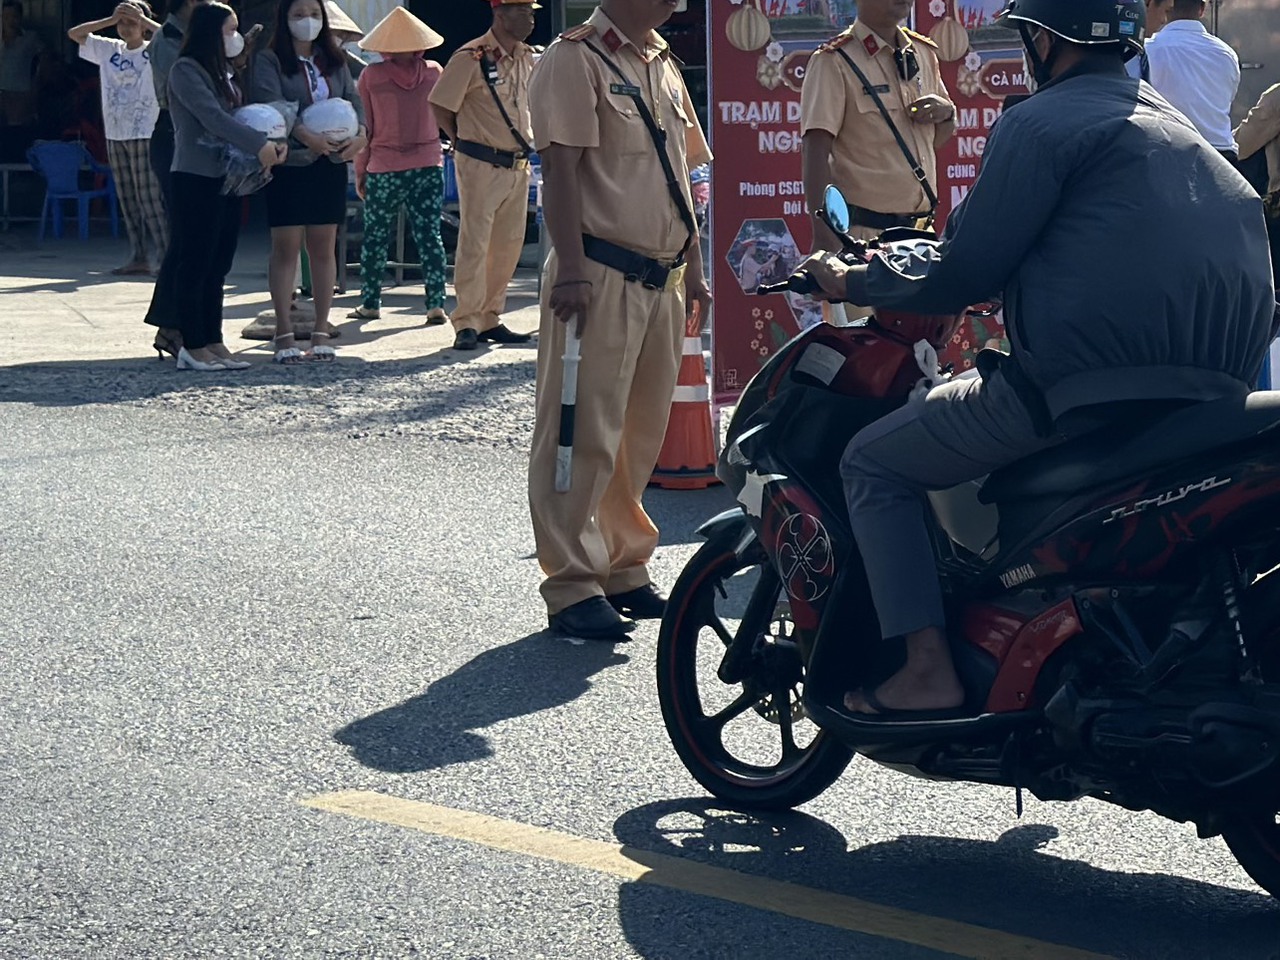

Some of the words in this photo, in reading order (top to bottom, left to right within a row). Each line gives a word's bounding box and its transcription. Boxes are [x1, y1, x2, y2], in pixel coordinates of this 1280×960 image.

[991, 71, 1010, 86] CÀ
[718, 100, 782, 129] TRẠM
[947, 161, 976, 179] CÙNG
[739, 181, 776, 197] Phòng
[783, 200, 801, 217] Đội
[999, 563, 1037, 589] YAMAHA
